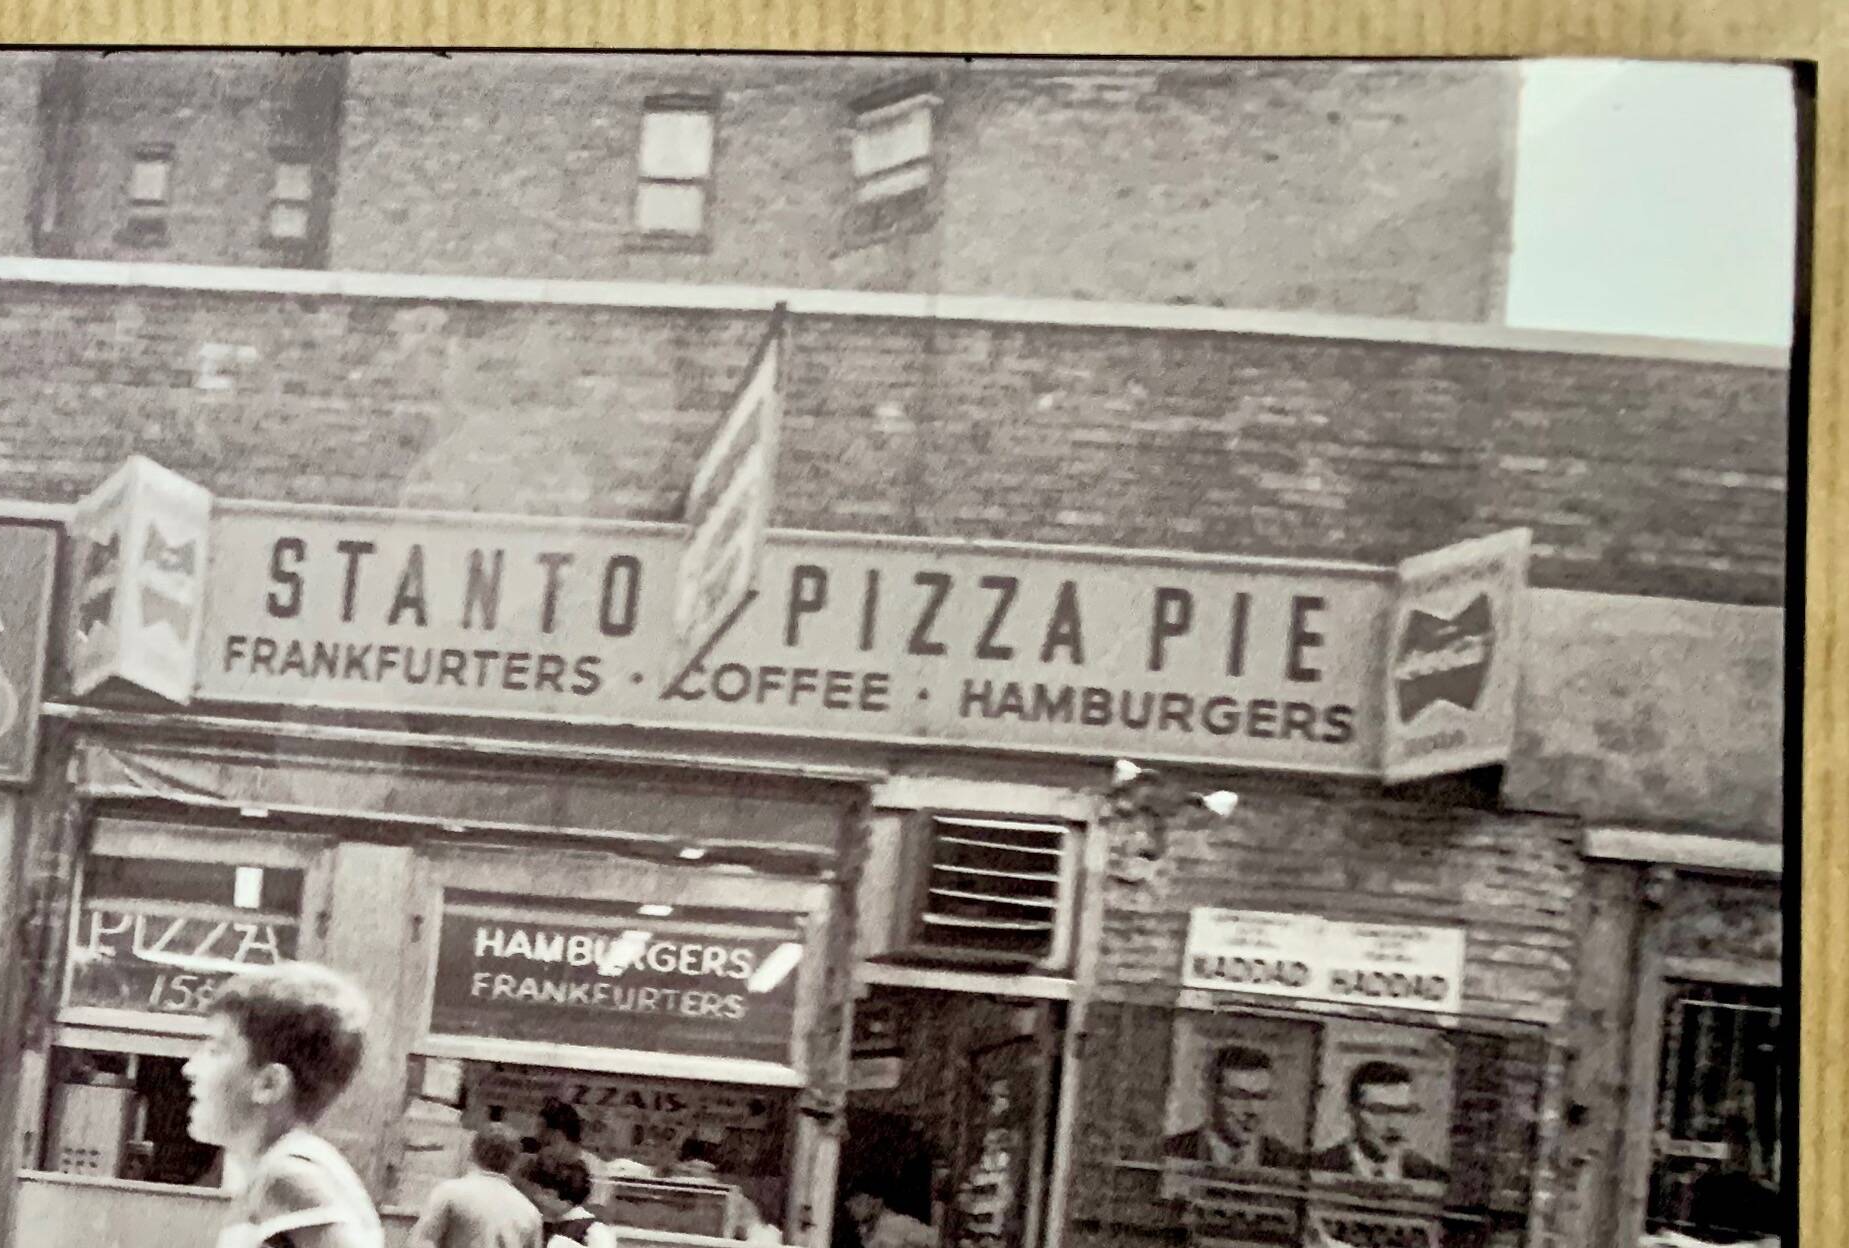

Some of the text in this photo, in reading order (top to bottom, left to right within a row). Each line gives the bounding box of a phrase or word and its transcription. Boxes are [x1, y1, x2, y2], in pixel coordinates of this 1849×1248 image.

[266, 535, 643, 638] STANTO
[785, 563, 1085, 666] PIZZA
[1151, 586, 1331, 682] PIE
[222, 634, 603, 697] FRANKFURTERS
[681, 660, 891, 713] COFFEE
[960, 678, 1355, 745] HAMBURGERS
[89, 910, 282, 967] PIZZA
[470, 971, 747, 1020] FRANKFURTERS
